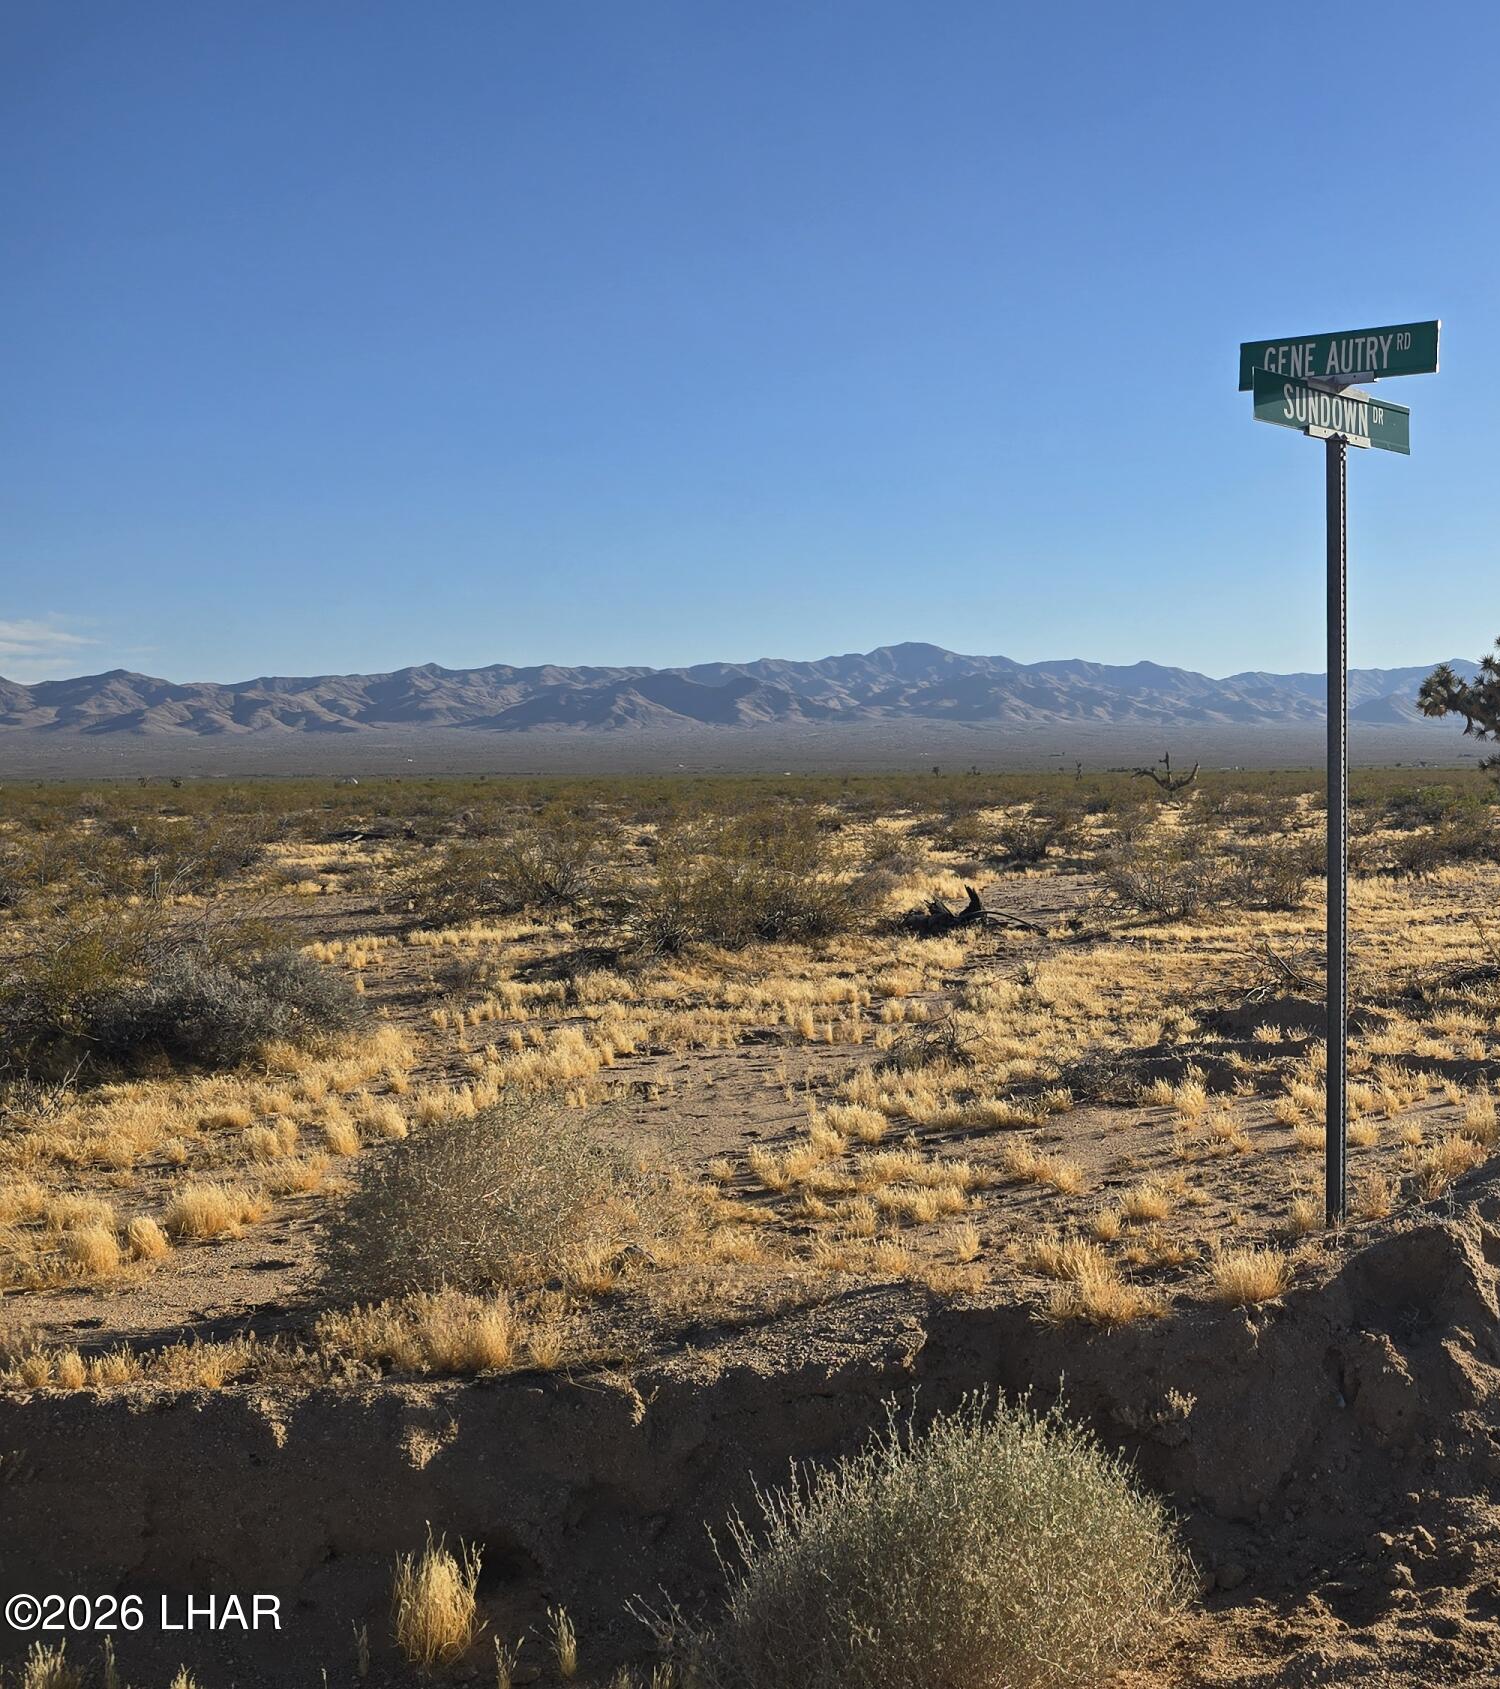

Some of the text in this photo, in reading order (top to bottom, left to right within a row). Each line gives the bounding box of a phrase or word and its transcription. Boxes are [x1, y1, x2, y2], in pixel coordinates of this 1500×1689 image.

[1264, 332, 1411, 377] GENE AUTRY RD
[1283, 383, 1384, 437] SUNDOWN DR
